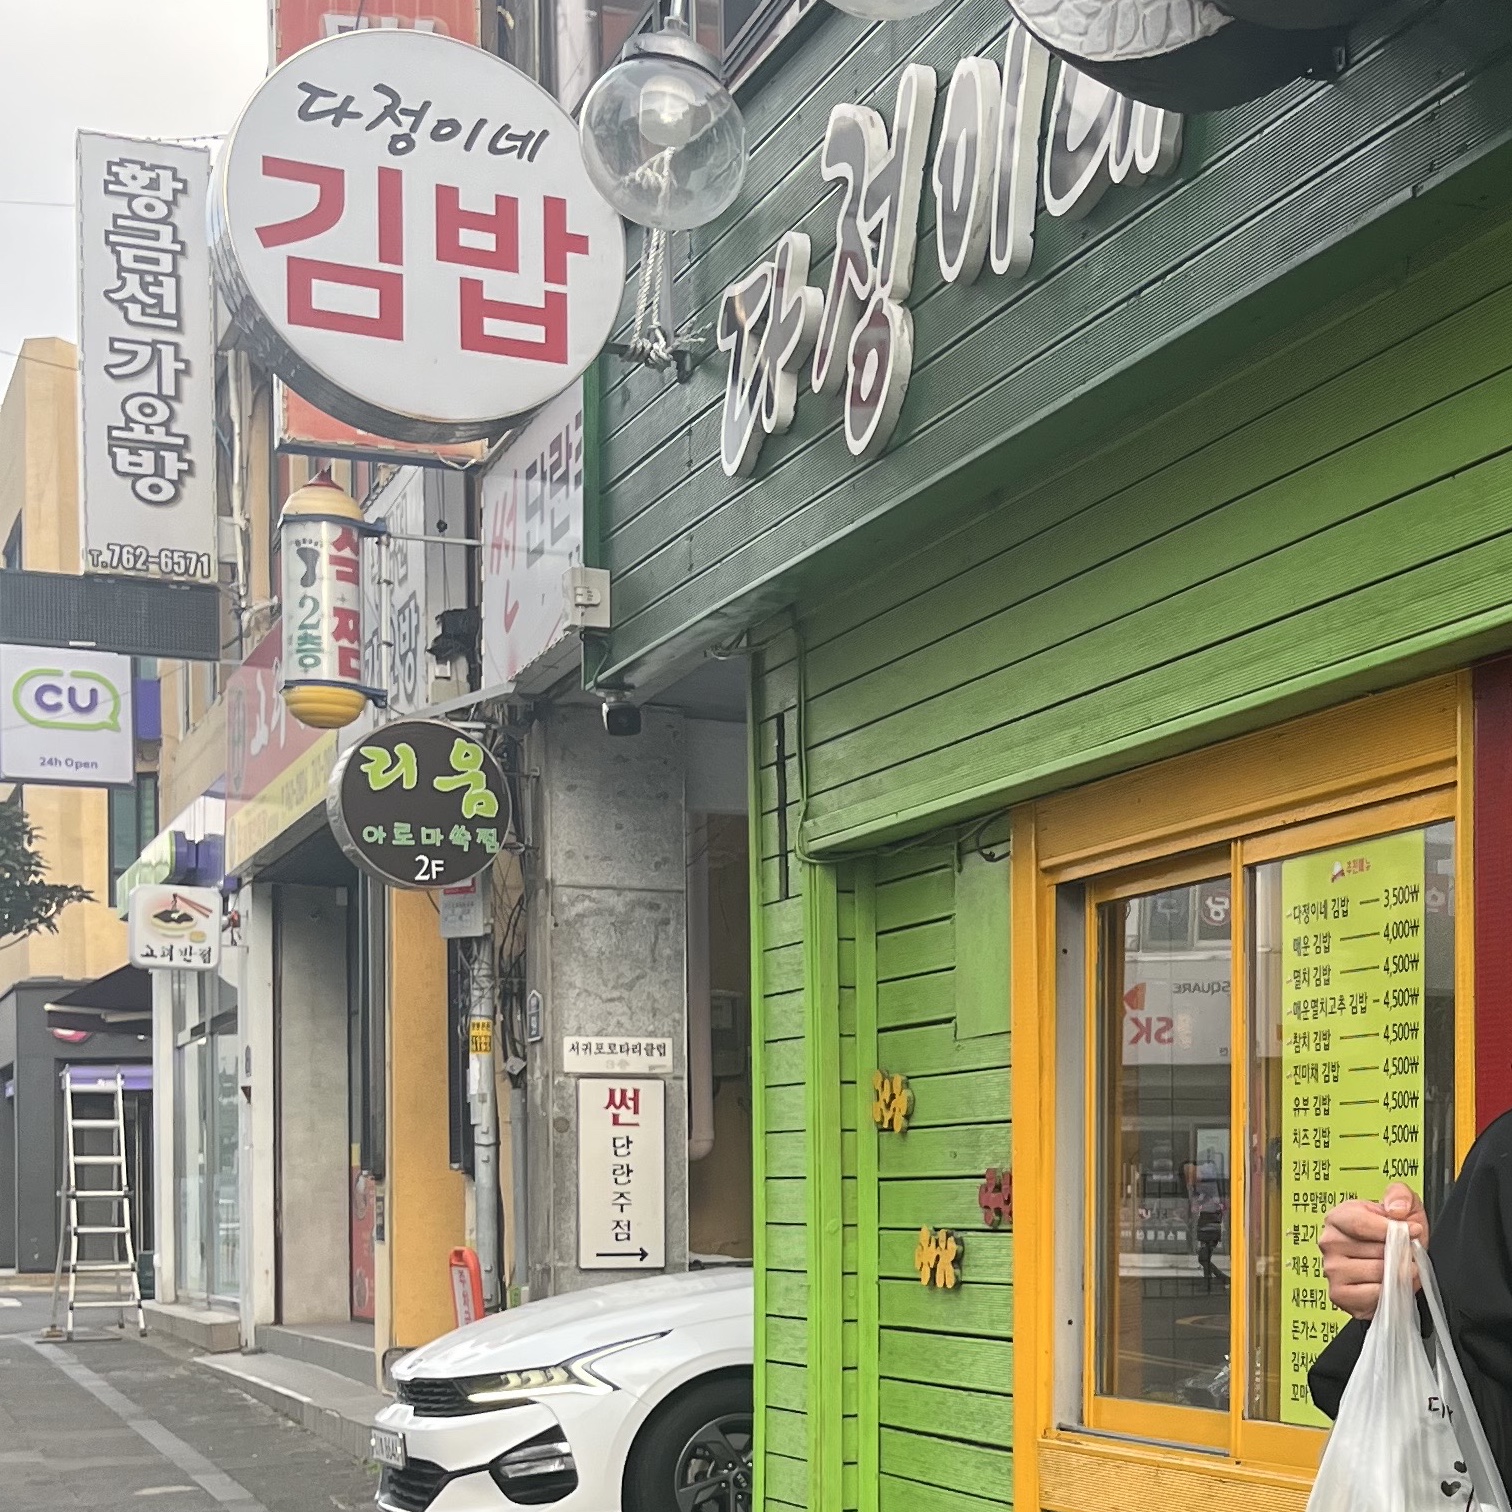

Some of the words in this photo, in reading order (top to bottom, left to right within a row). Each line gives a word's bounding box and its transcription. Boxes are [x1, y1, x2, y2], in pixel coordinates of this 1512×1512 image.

[297, 82, 549, 163] 다정이네
[104, 158, 188, 333] 황금선
[255, 155, 590, 364] 김밥
[104, 336, 192, 505] 가요방
[35, 683, 99, 713] CU
[39, 756, 62, 768] 24h
[65, 757, 99, 771] Open
[360, 737, 499, 819] 리움
[414, 854, 445, 881] 2F
[1293, 899, 1328, 924] 다정이네
[1331, 896, 1349, 919] 김밥
[1313, 931, 1331, 954] 김밥
[1292, 968, 1310, 990] 멸치
[1313, 965, 1331, 987] 김밥
[1349, 992, 1368, 1015] 김밥
[1313, 1029, 1331, 1052] 김밥
[1293, 1062, 1319, 1085] 진미채
[1322, 1061, 1340, 1083] 김밥
[603, 1087, 641, 1127] 썬
[1293, 1096, 1310, 1117] 유부
[1313, 1094, 1331, 1116] 김밥
[1293, 1127, 1310, 1148] 치즈
[1313, 1127, 1331, 1148] 김밥
[1293, 1160, 1310, 1181] 김치
[1313, 1159, 1331, 1181] 김밥
[611, 1135, 634, 1242] 단란주점
[1293, 1224, 1318, 1246] 불고기
[1292, 1255, 1310, 1277] 제육
[1313, 1256, 1327, 1278] 김
